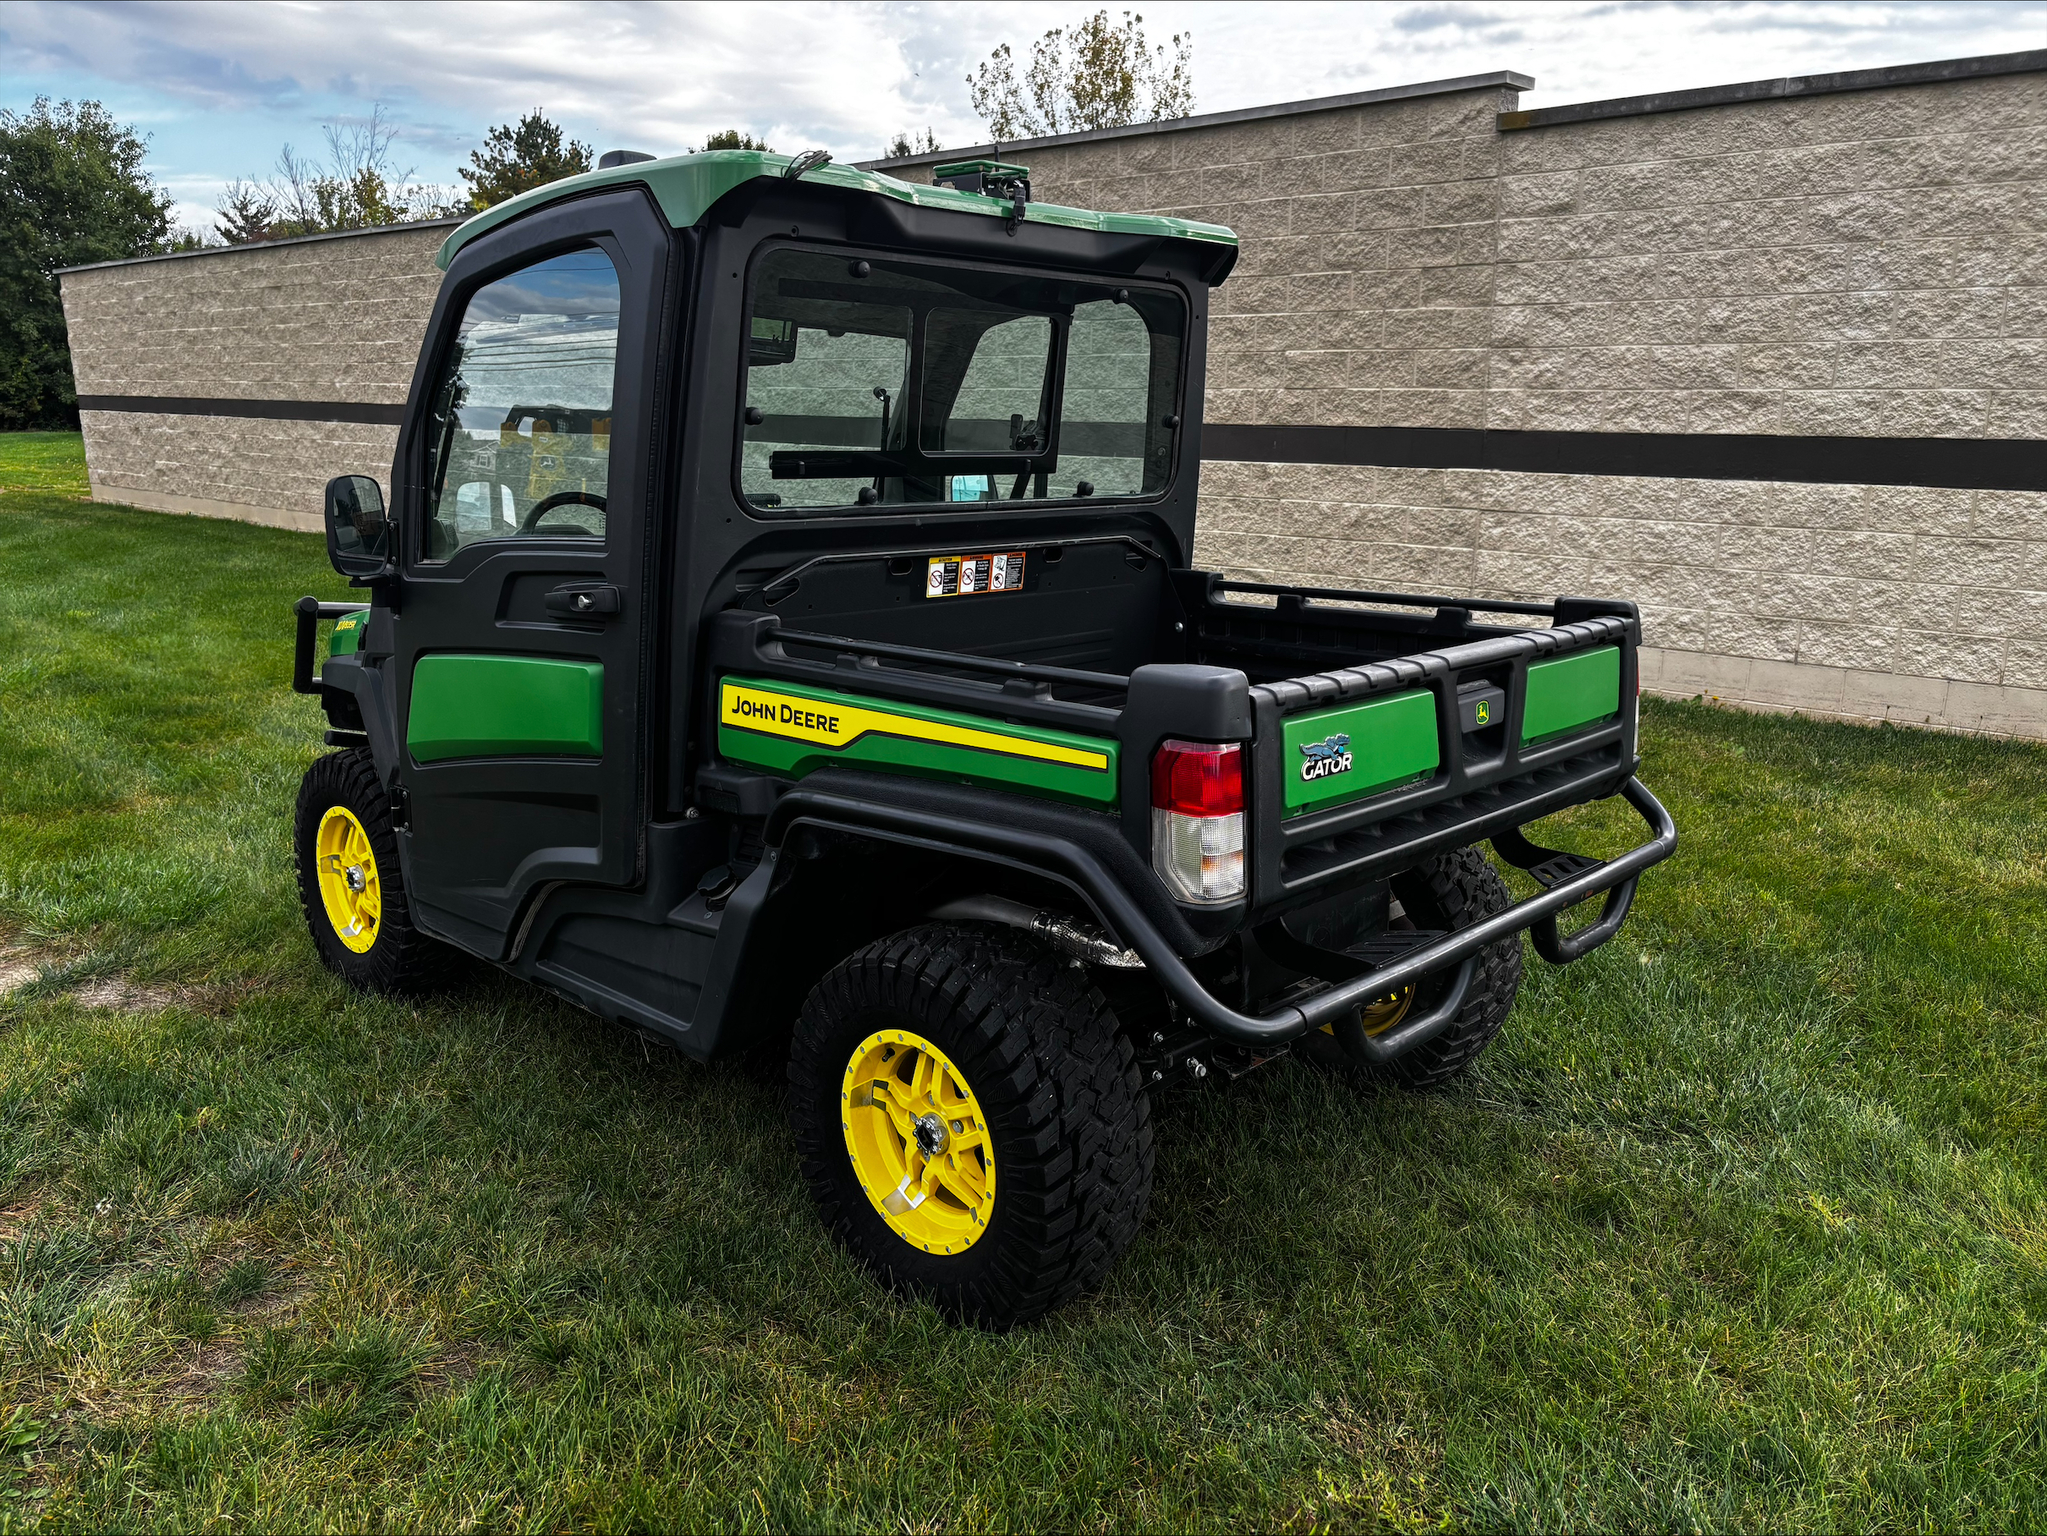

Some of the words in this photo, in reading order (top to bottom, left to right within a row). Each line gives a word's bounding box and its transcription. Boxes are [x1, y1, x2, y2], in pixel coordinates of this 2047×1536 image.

[732, 695, 776, 721] JOHN
[780, 704, 839, 734] DEERE
[1302, 753, 1352, 780] GATOR
